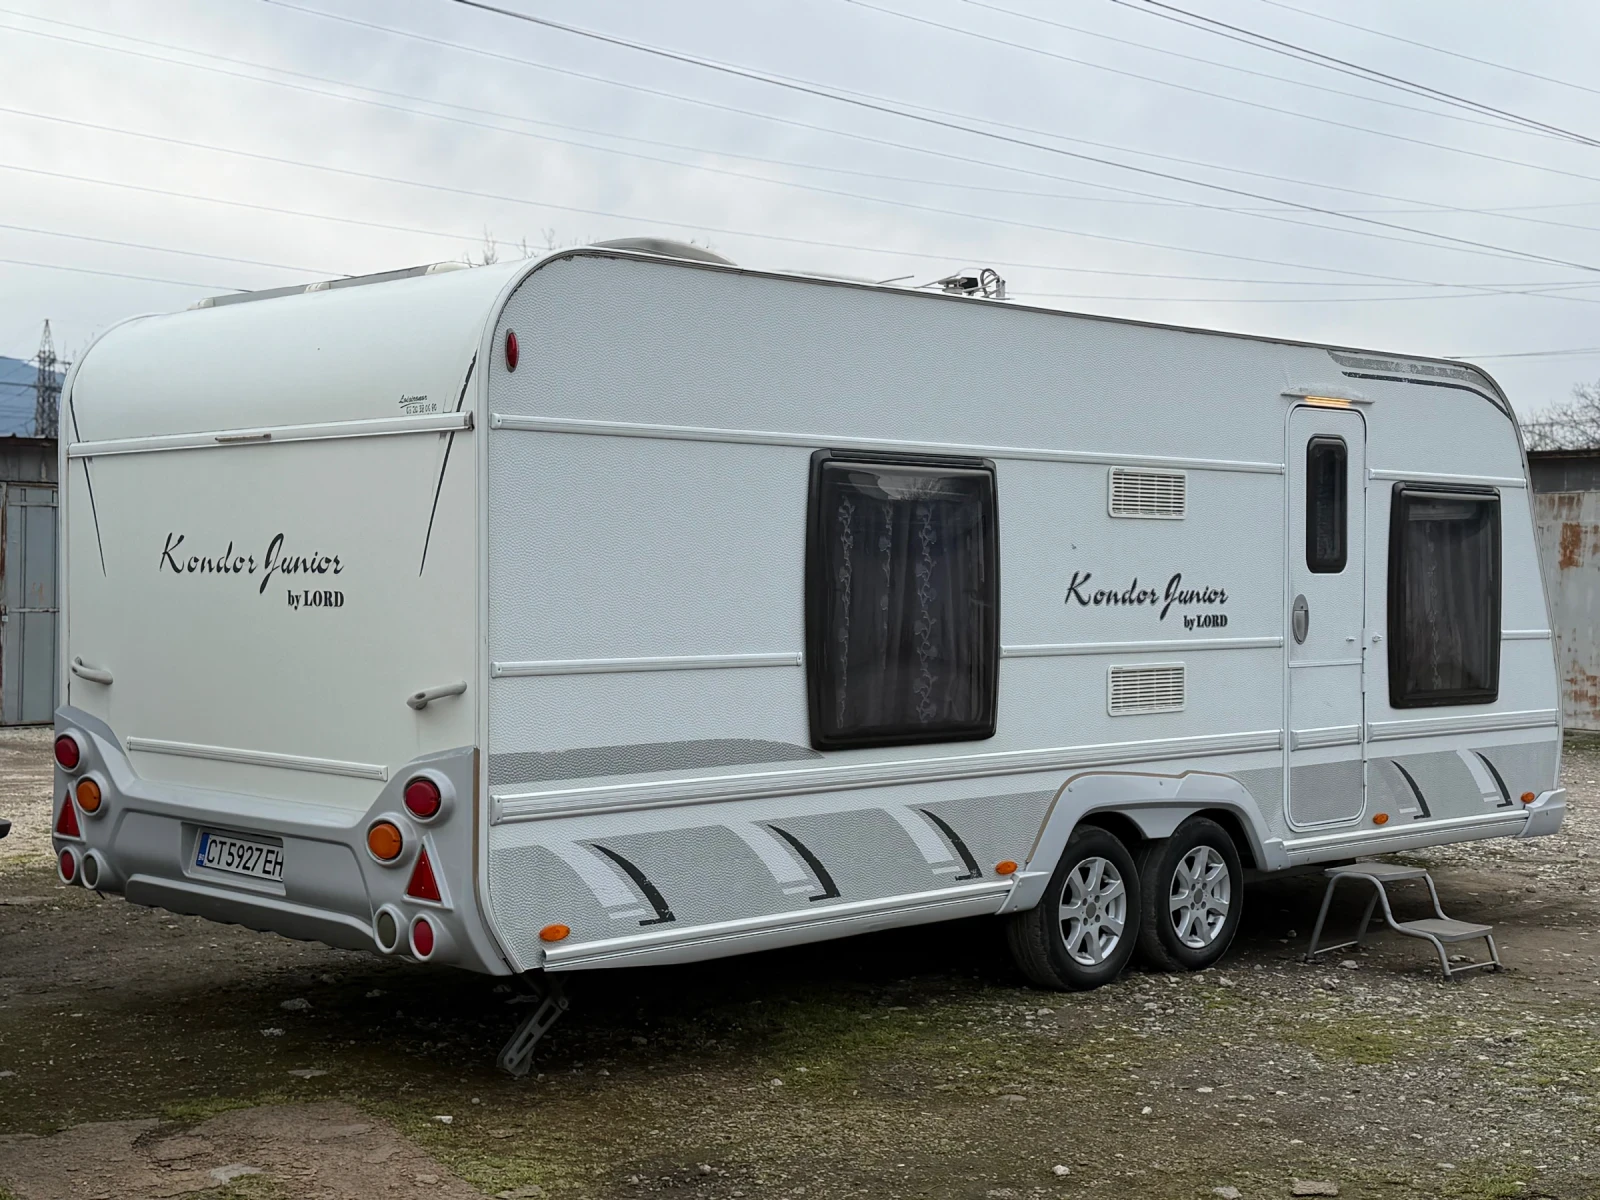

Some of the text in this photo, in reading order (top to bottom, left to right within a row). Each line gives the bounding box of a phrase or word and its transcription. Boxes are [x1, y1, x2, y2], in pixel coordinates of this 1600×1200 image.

[159, 532, 345, 595] Kondor Junior
[287, 590, 345, 610] by LORD
[1064, 570, 1229, 621] Kondor Junior
[1183, 614, 1229, 631] by LORD
